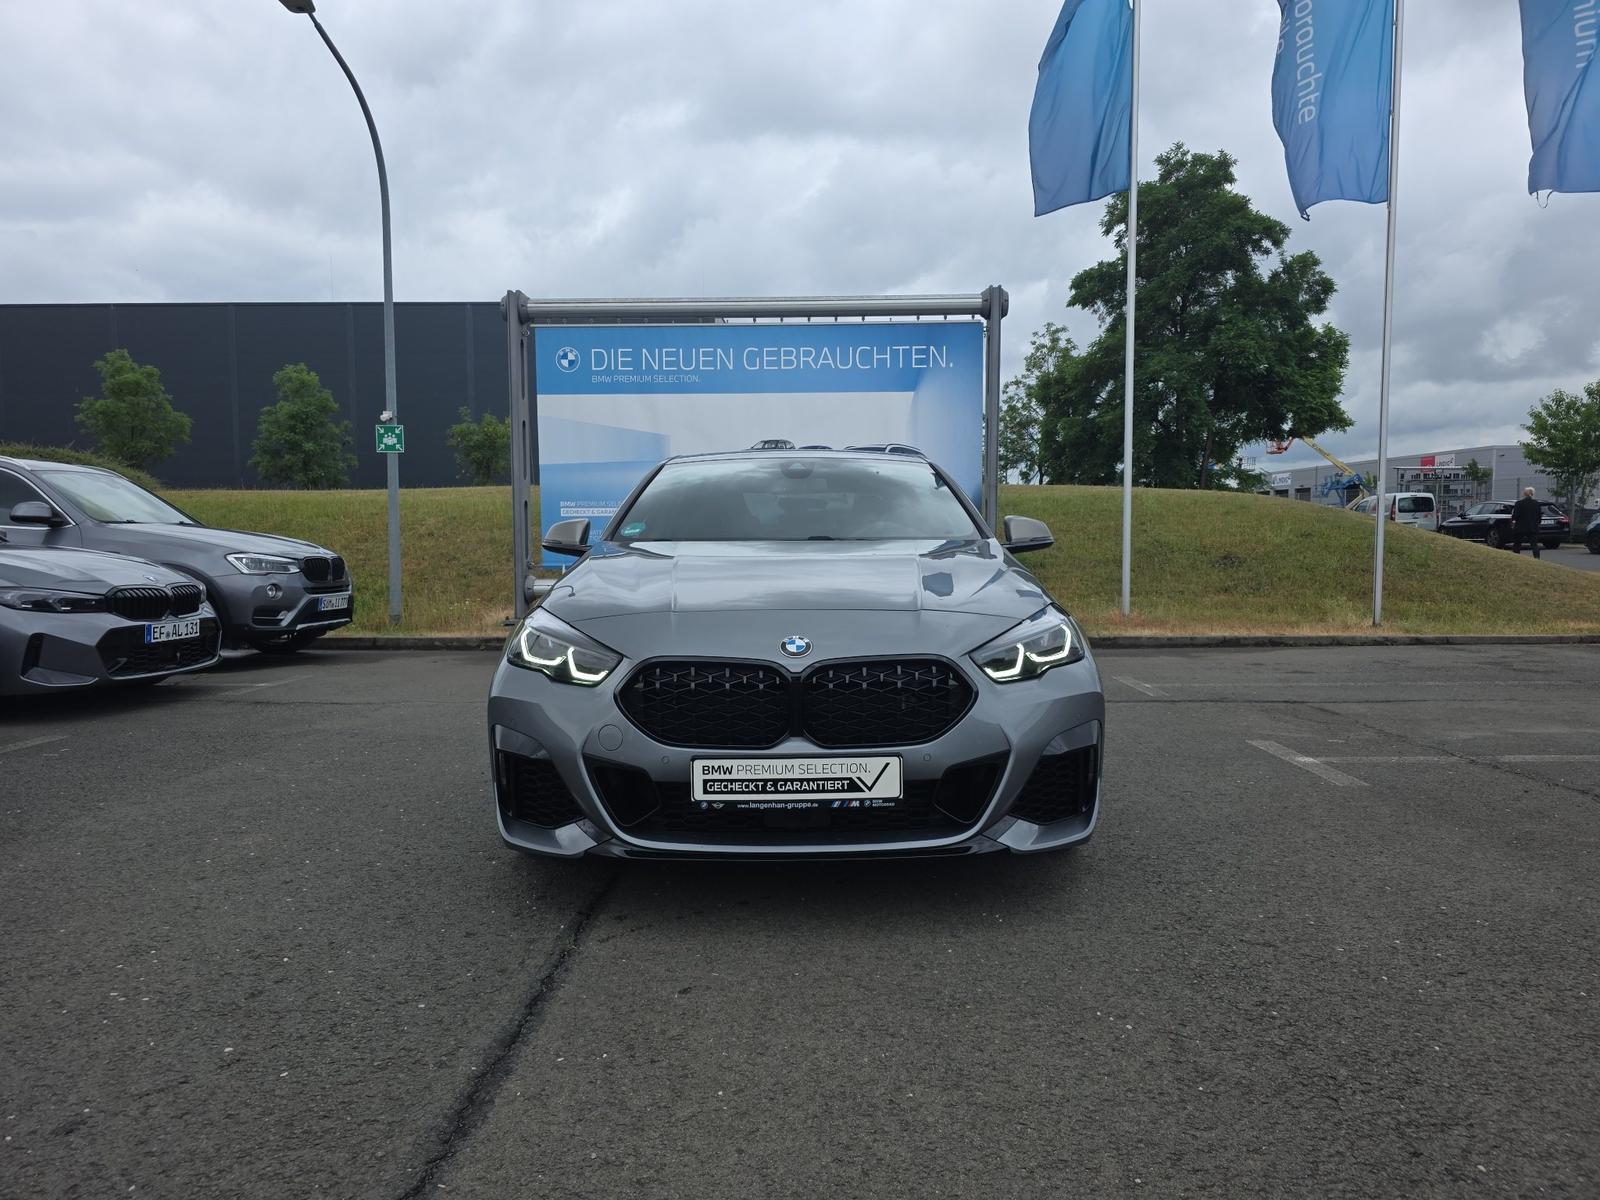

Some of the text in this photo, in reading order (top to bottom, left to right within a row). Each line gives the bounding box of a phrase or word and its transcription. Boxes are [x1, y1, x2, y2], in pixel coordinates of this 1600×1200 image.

[591, 345, 954, 371] DIE NEUEN GEBRAUCHTEN.
[591, 375, 612, 383] BMW
[613, 375, 651, 383] PREMIUM
[153, 621, 199, 640] EF AL 131
[702, 762, 871, 776] BMW PREMIUM SELECTION.
[706, 780, 850, 792] GECHECKT & GARANTIERT
[737, 801, 819, 809] www.langenhan-gruppe.de
